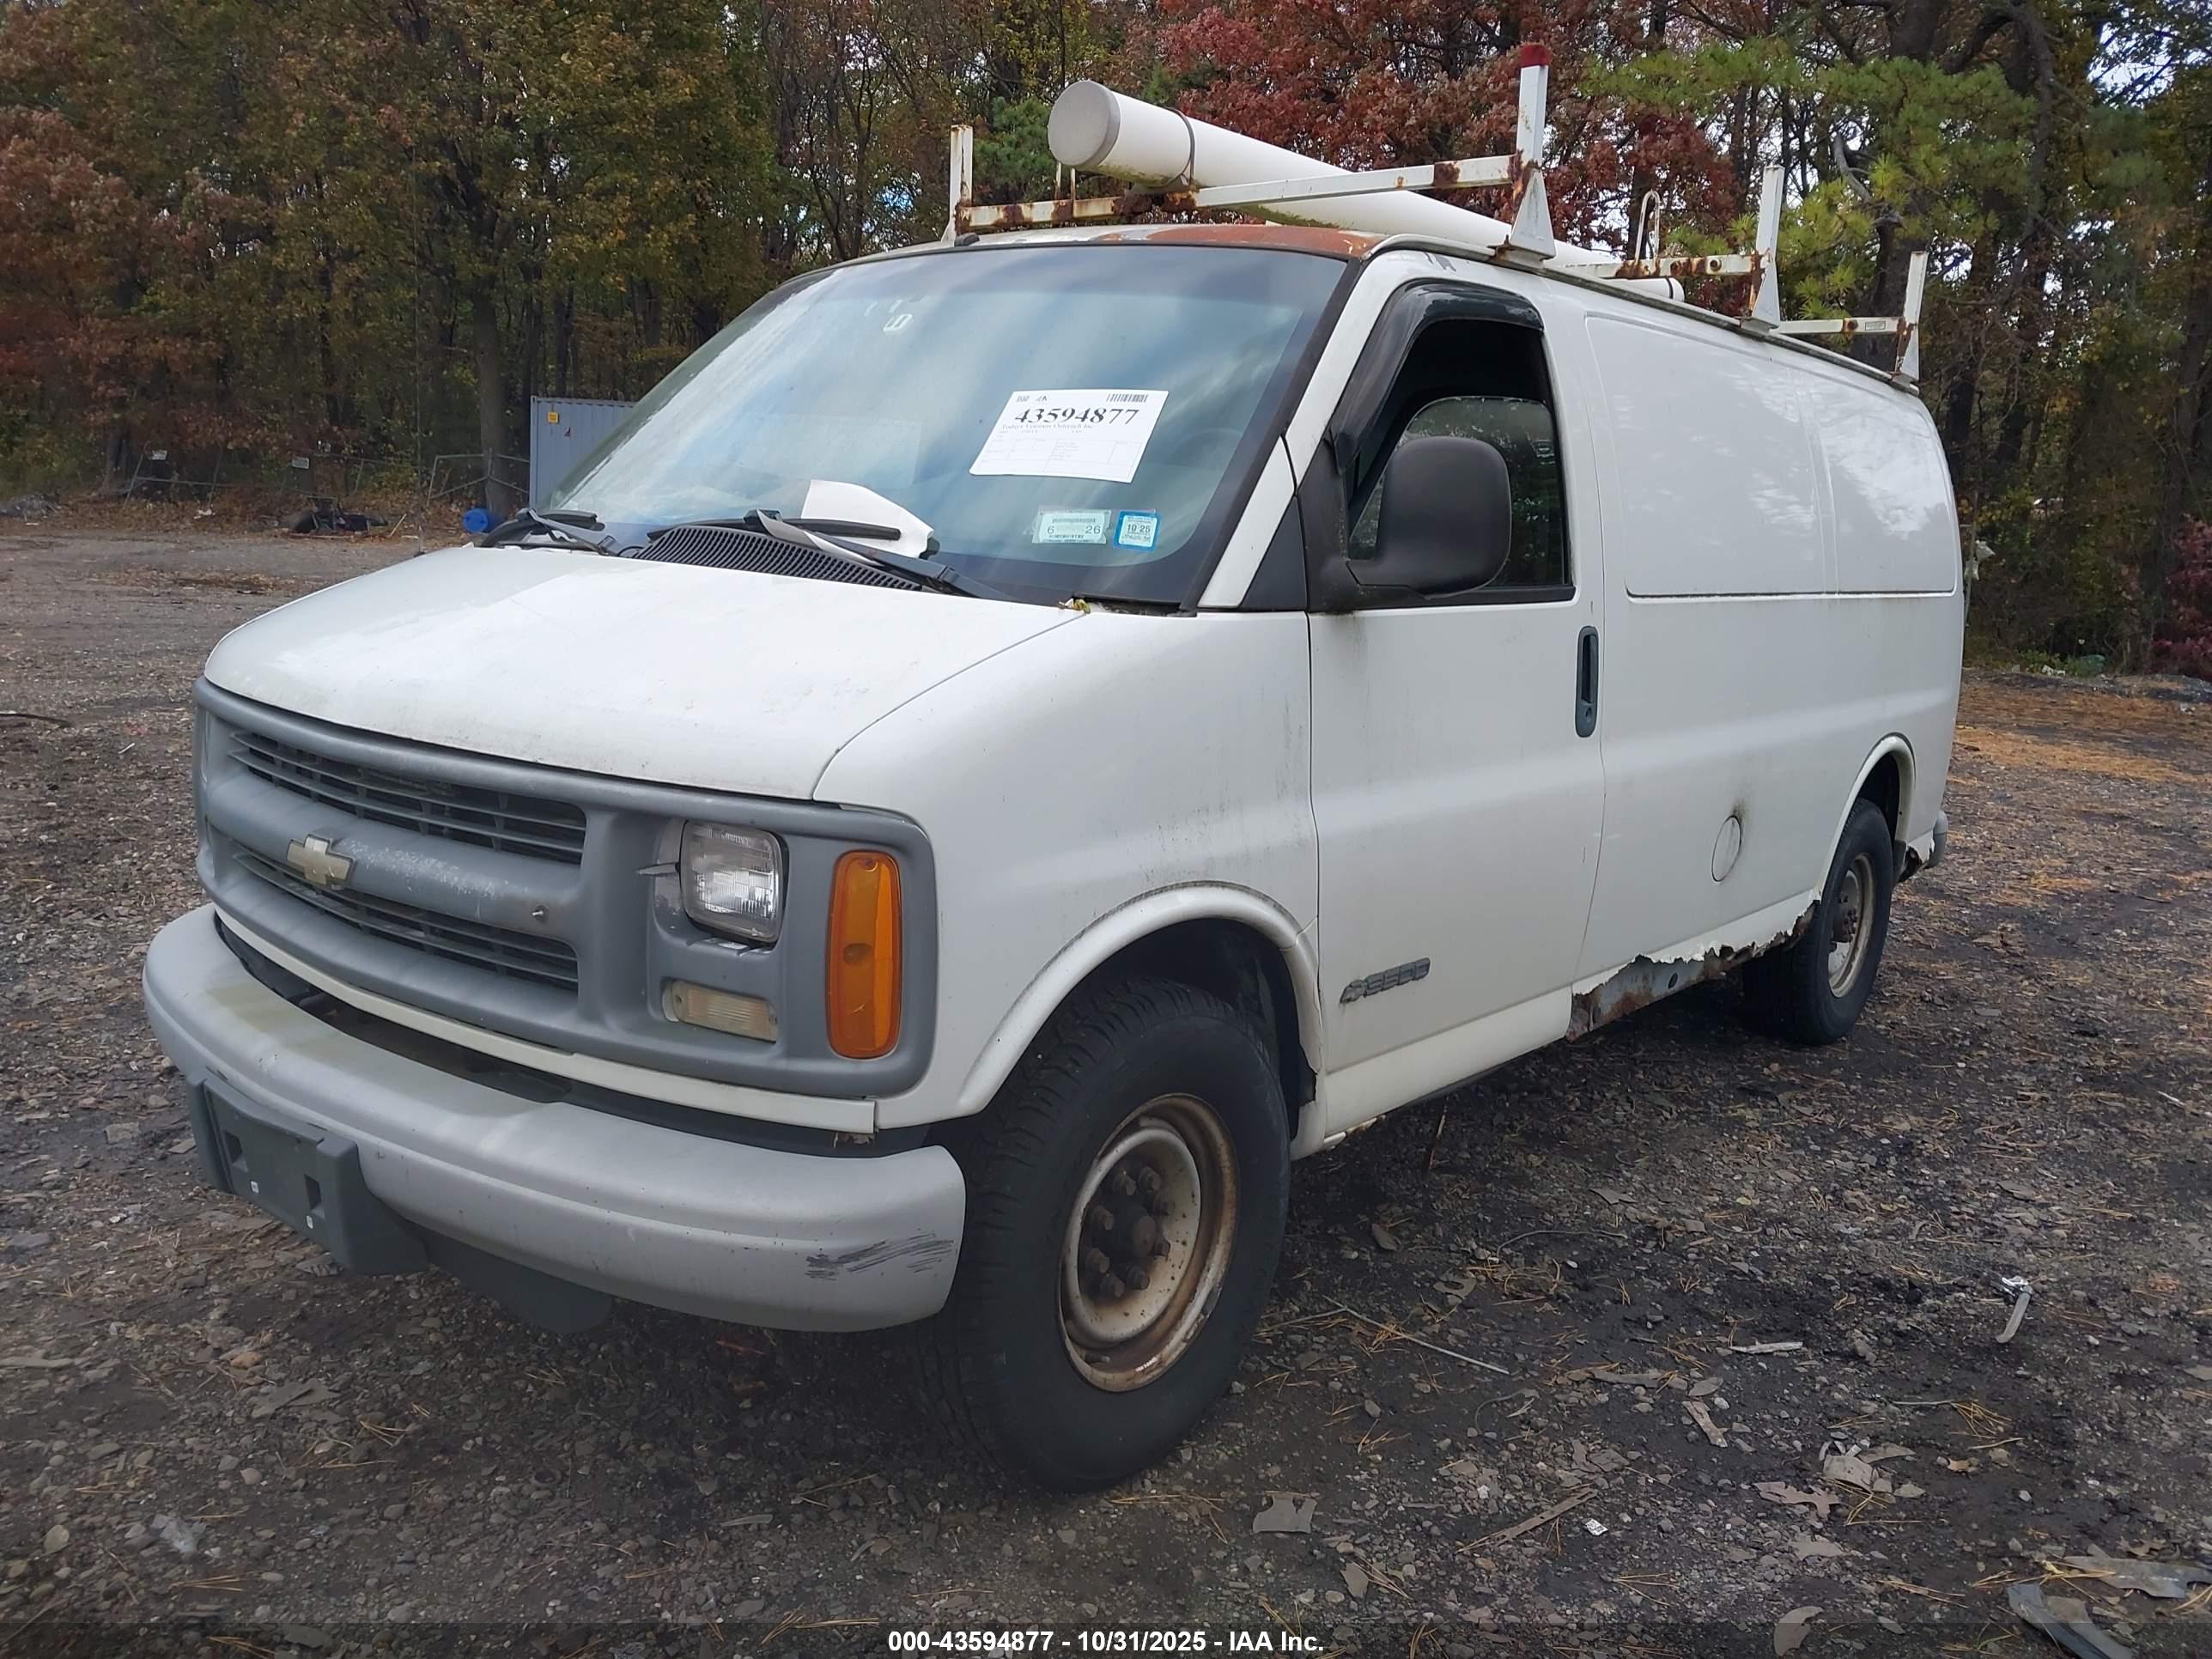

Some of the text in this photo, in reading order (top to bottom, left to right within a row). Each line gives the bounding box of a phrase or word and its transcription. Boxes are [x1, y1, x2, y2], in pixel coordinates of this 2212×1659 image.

[1015, 407, 1139, 425] 43594877
[1047, 526, 1101, 534] 6 26
[1139, 525, 1151, 533] 25
